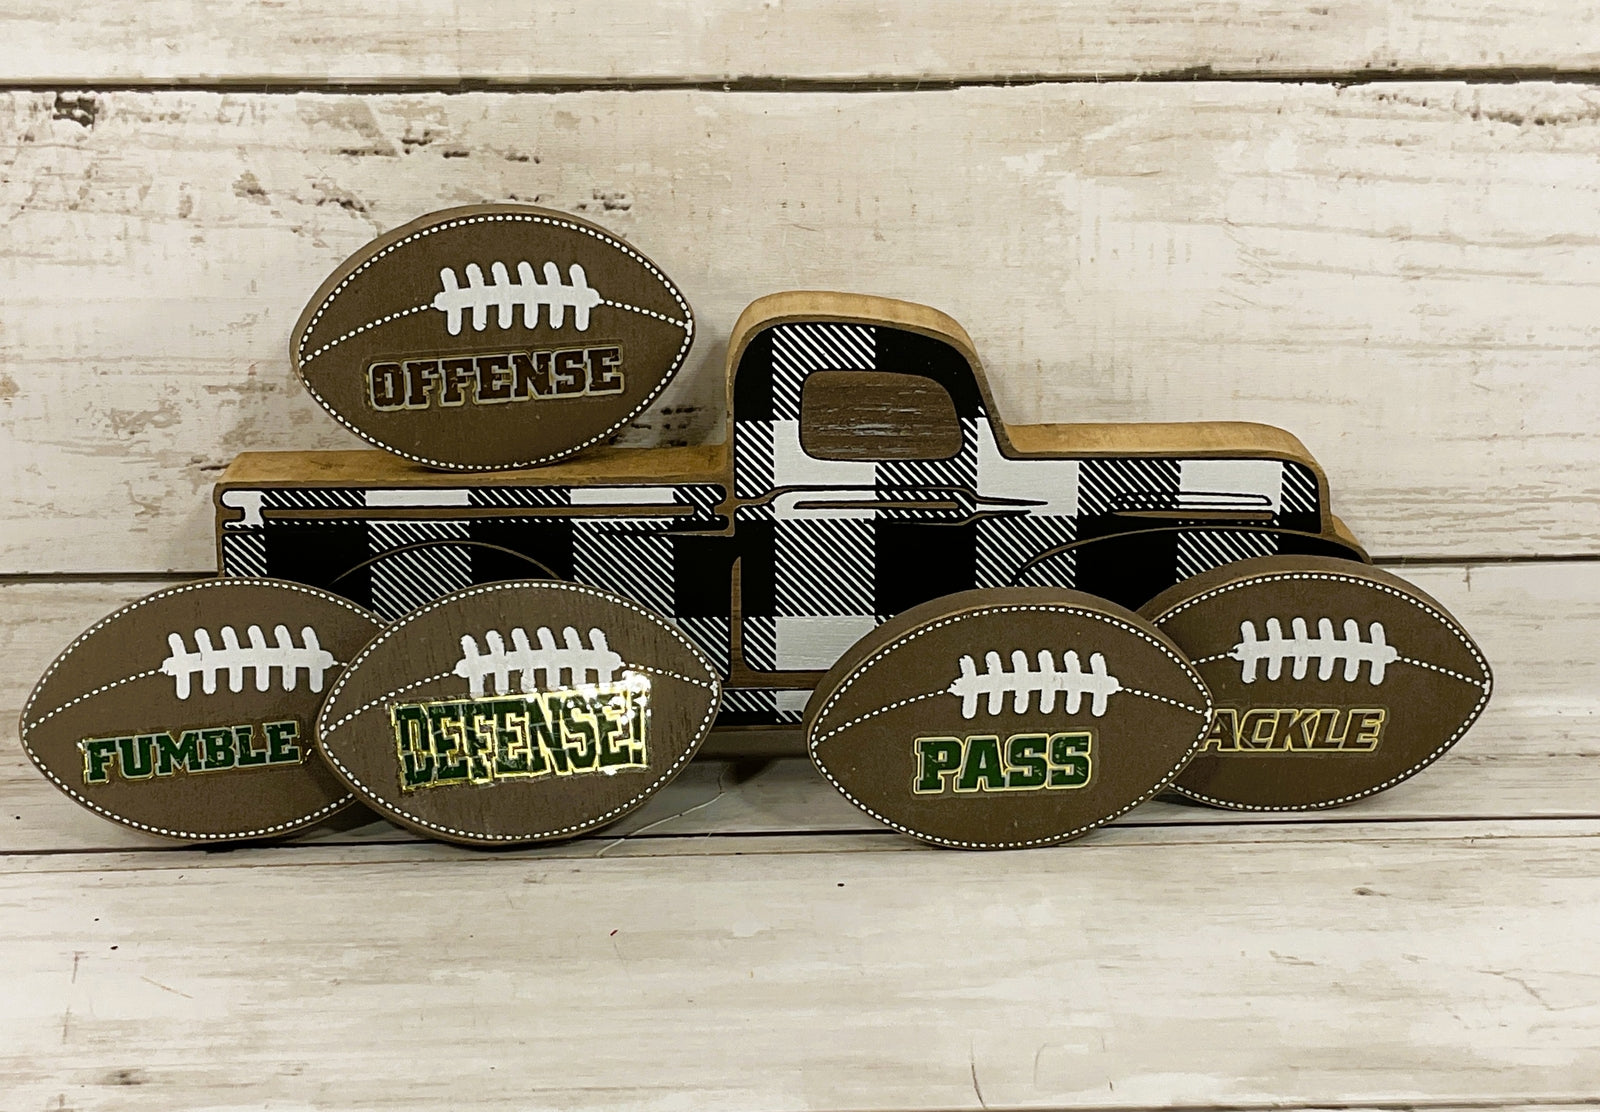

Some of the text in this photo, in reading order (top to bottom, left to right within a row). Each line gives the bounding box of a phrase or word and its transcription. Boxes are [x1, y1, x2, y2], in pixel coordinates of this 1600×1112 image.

[369, 346, 625, 411] OFFENSE
[82, 720, 302, 783] FUMBLE
[1197, 708, 1386, 752] ACKLE
[913, 731, 1092, 794] PASS
